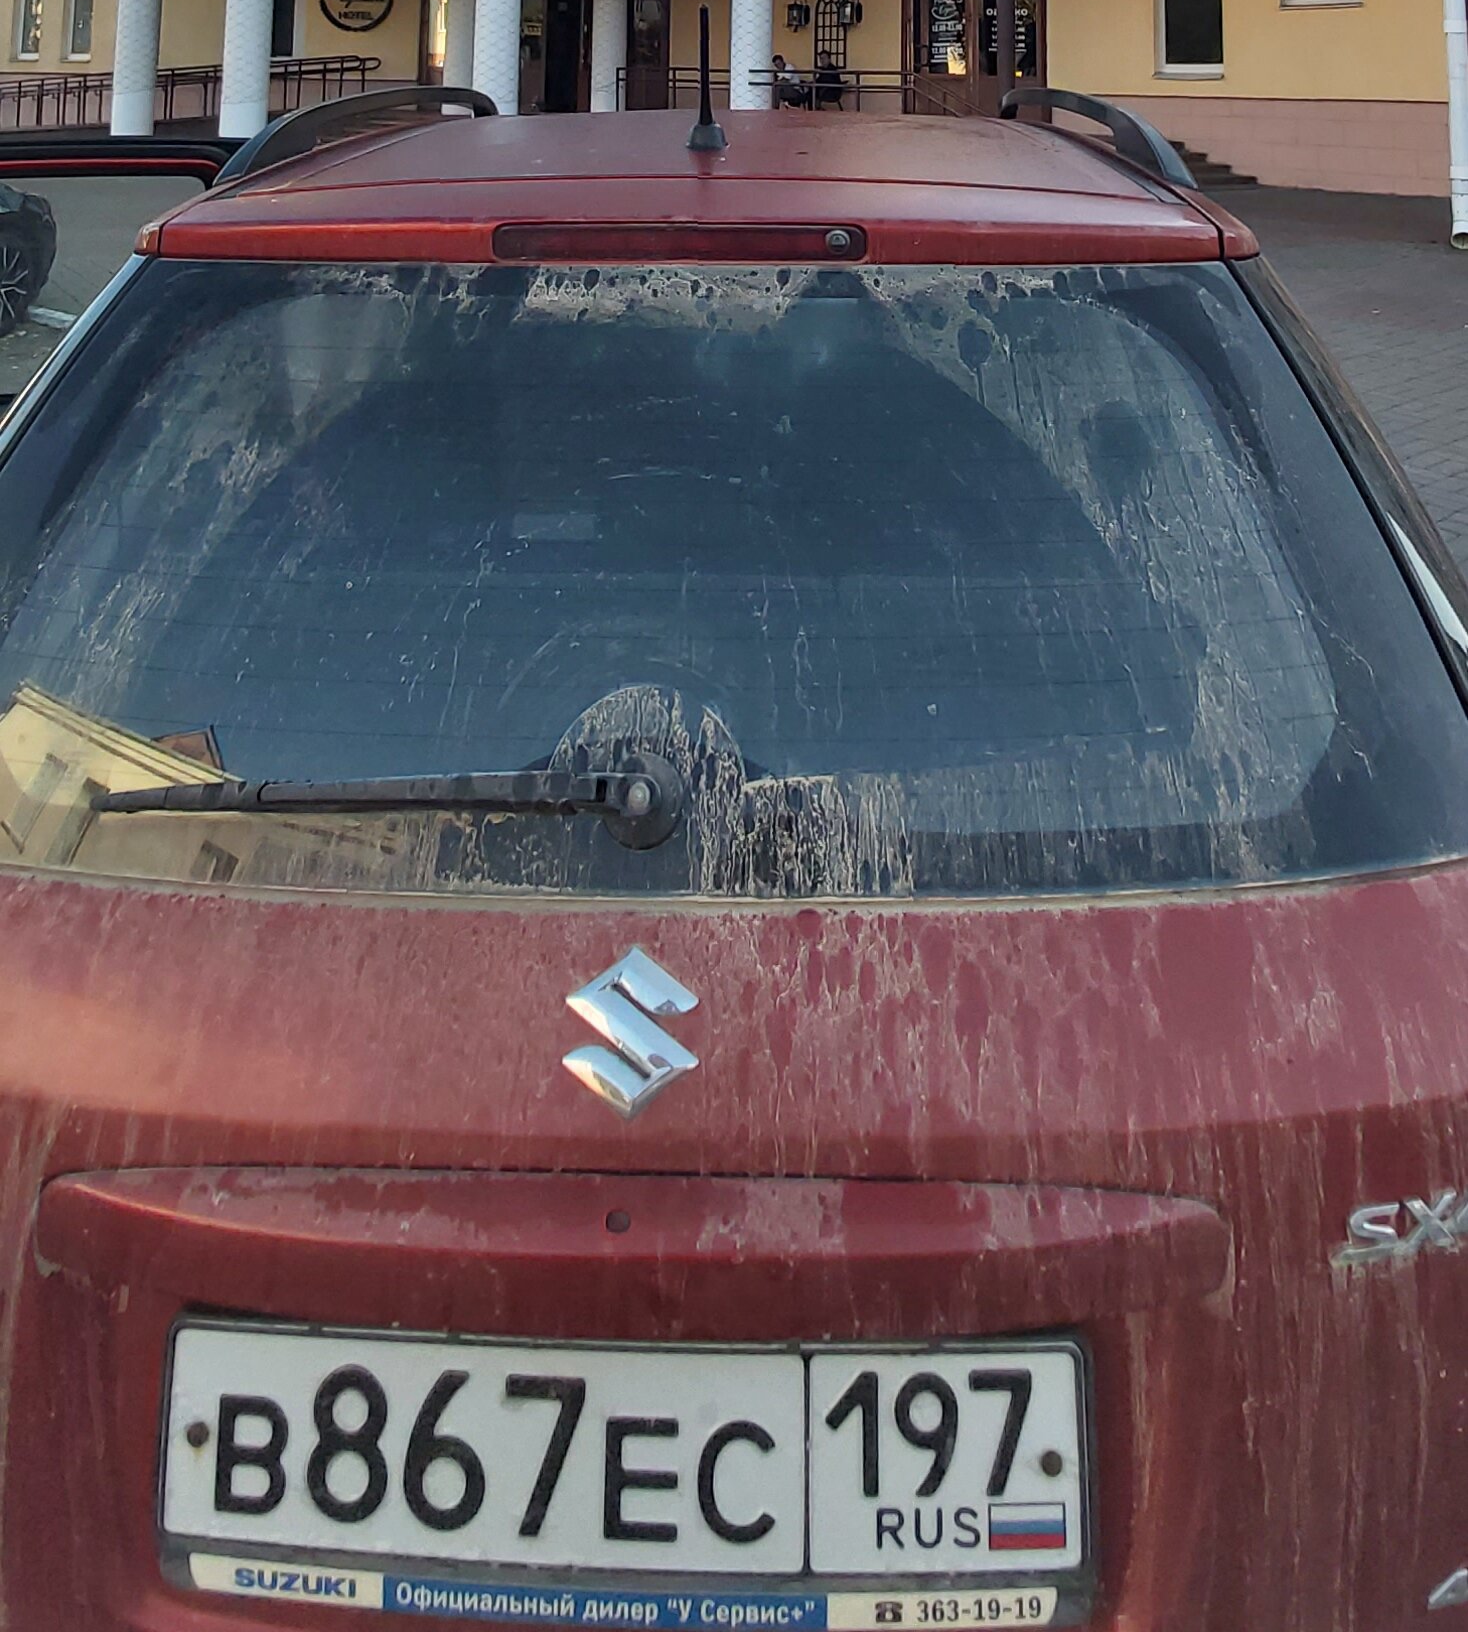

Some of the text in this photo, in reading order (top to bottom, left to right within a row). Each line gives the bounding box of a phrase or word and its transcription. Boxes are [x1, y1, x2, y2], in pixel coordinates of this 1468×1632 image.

[1328, 1188, 1468, 1266] SX
[825, 1368, 1032, 1499] 197
[875, 1507, 981, 1550] RUS
[234, 1567, 357, 1599] SUZUKI
[396, 1582, 576, 1618] Официальный
[582, 1601, 659, 1624] дилер
[916, 1596, 1042, 1623] 363-19-19
